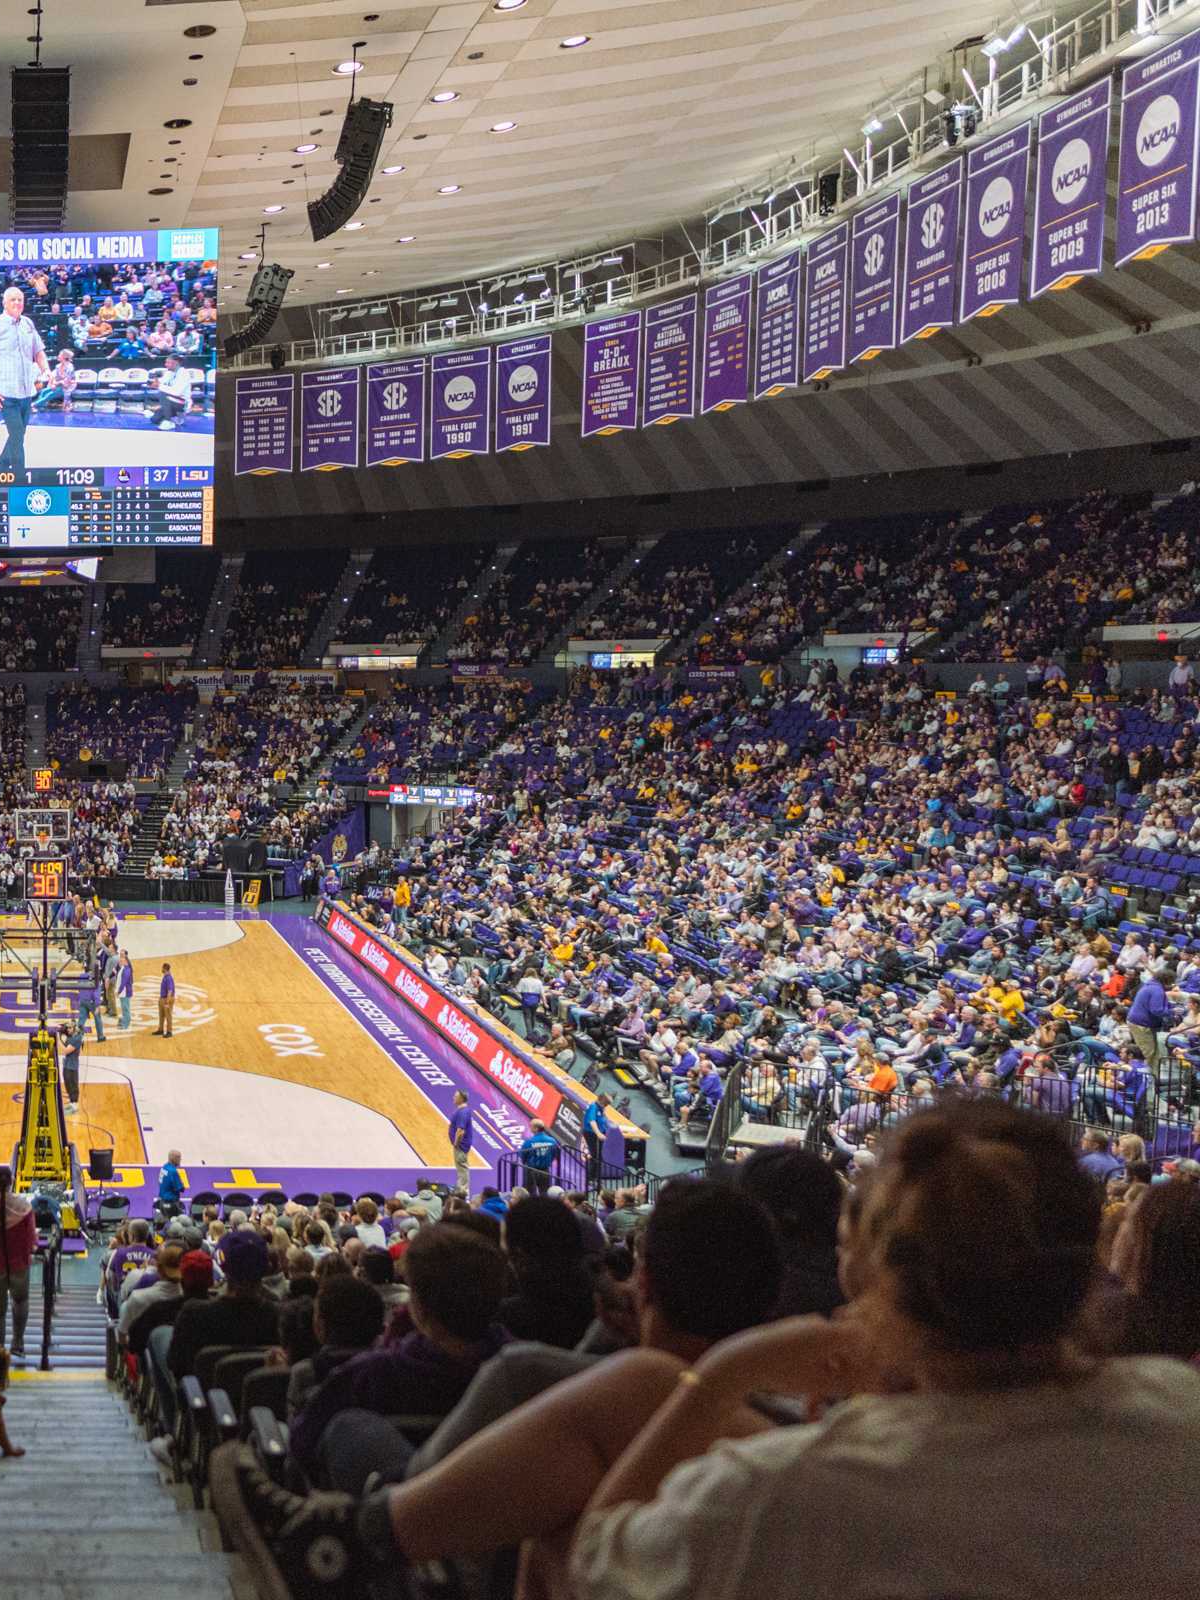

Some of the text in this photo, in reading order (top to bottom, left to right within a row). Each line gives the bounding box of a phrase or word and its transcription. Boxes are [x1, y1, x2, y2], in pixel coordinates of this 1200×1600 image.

[1141, 49, 1182, 79] GYMNASTICS
[1056, 96, 1093, 123] GYMNASTICS
[1141, 121, 1178, 154] NCAA
[1056, 163, 1088, 193] NCAA
[1132, 181, 1177, 212] SUPER SIX
[983, 200, 1010, 226] NCAA
[1135, 203, 1170, 234] 2013
[921, 202, 945, 249] SEC
[1048, 218, 1088, 246] SUPER SIX
[18, 238, 38, 261] ON
[42, 237, 94, 260] SOCIAL
[97, 235, 144, 259] MEDIA
[1050, 236, 1084, 267] 2009
[916, 250, 945, 270] CHAMPIONS
[975, 251, 1011, 276] SUPER SIX
[815, 260, 836, 282] NCAA
[977, 268, 1007, 296] 2008
[767, 283, 789, 304] NCAA
[712, 315, 742, 332] CHAMPIONS
[715, 308, 739, 323] NATIONAL
[653, 333, 686, 350] CHAMPIONS
[657, 326, 683, 342] NATIONAL
[511, 343, 537, 354] VOLLEYBALL
[598, 344, 626, 361] "D-D"
[447, 355, 474, 365] VOLLEYBALL
[593, 354, 631, 373] BREAUX
[383, 381, 408, 410] SEC
[447, 390, 476, 404] NCAA
[511, 380, 537, 394] NCAA
[249, 397, 278, 409] NCAA
[317, 389, 342, 417] SEC
[380, 413, 411, 422] CHAMPIONS
[442, 421, 477, 433] FINAL FOUR
[506, 412, 539, 425] FINAL FOUR
[447, 431, 471, 445] 1990
[512, 422, 533, 437] 1991
[25, 471, 32, 484] 1
[56, 469, 95, 485] 11:09
[153, 469, 169, 482] 37
[182, 470, 209, 481] LSU
[192, 674, 223, 686] Southe
[35, 778, 50, 790] 30
[32, 862, 63, 875] 11:09
[33, 874, 59, 897] 30
[303, 947, 455, 1087] PETE MARAVICH ASSEMBLY CENTER
[256, 1022, 326, 1057] COX
[446, 1012, 481, 1053] StateFarm
[500, 1056, 544, 1110] StateFarm
